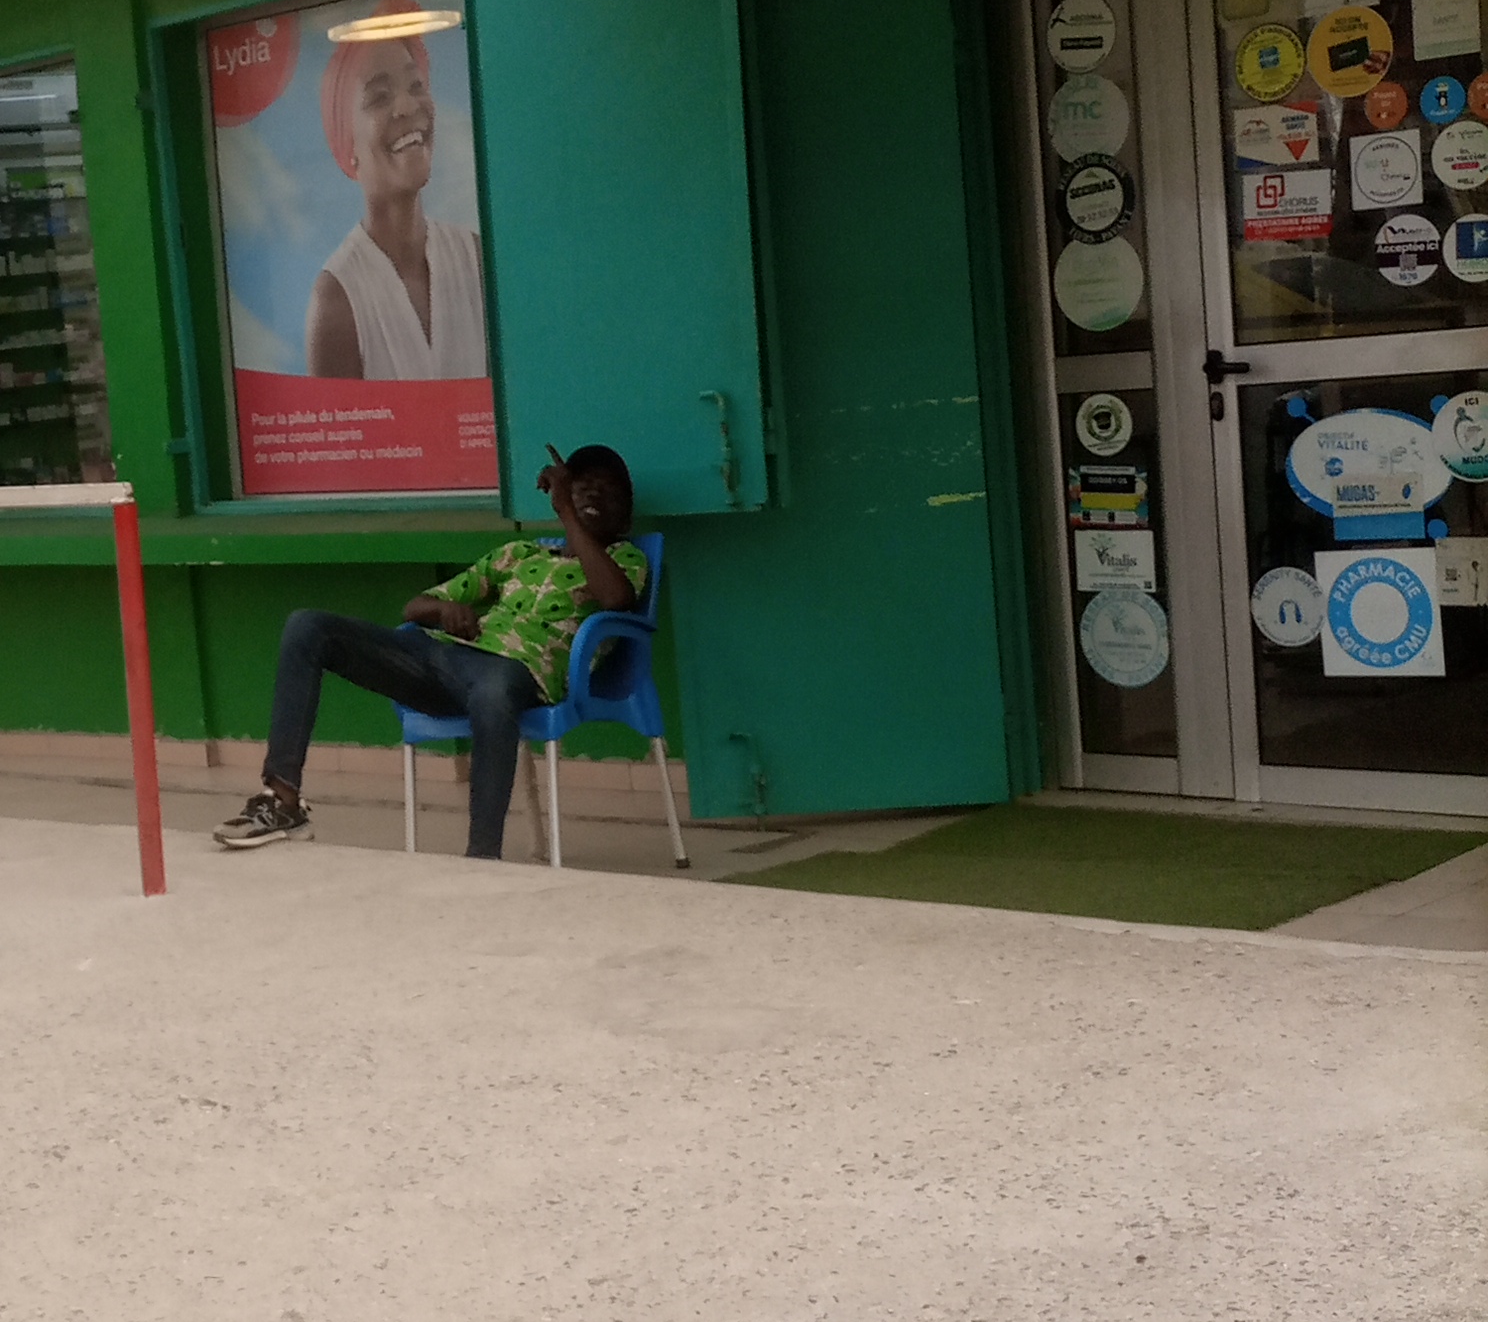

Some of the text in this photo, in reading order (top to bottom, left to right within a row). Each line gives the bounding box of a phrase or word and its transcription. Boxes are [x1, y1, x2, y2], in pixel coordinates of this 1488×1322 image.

[213, 38, 271, 75] Lydia
[1279, 196, 1320, 207] CHORUS
[1376, 242, 1425, 254] Acceptée
[1464, 397, 1479, 406] ICI
[251, 406, 395, 426] Pour la pilule du lendemain,
[253, 433, 286, 446] prenez
[289, 429, 324, 443] conseil
[1317, 438, 1369, 452] VITALITÉ
[255, 451, 268, 464] de
[270, 450, 295, 463] votre
[297, 446, 357, 465] pharmacien
[359, 449, 374, 460] ou
[1095, 548, 1138, 567] Vitalis
[1334, 561, 1420, 603] PHARMACIE
[1335, 625, 1393, 664] agréée
[1394, 622, 1428, 660] CMU
